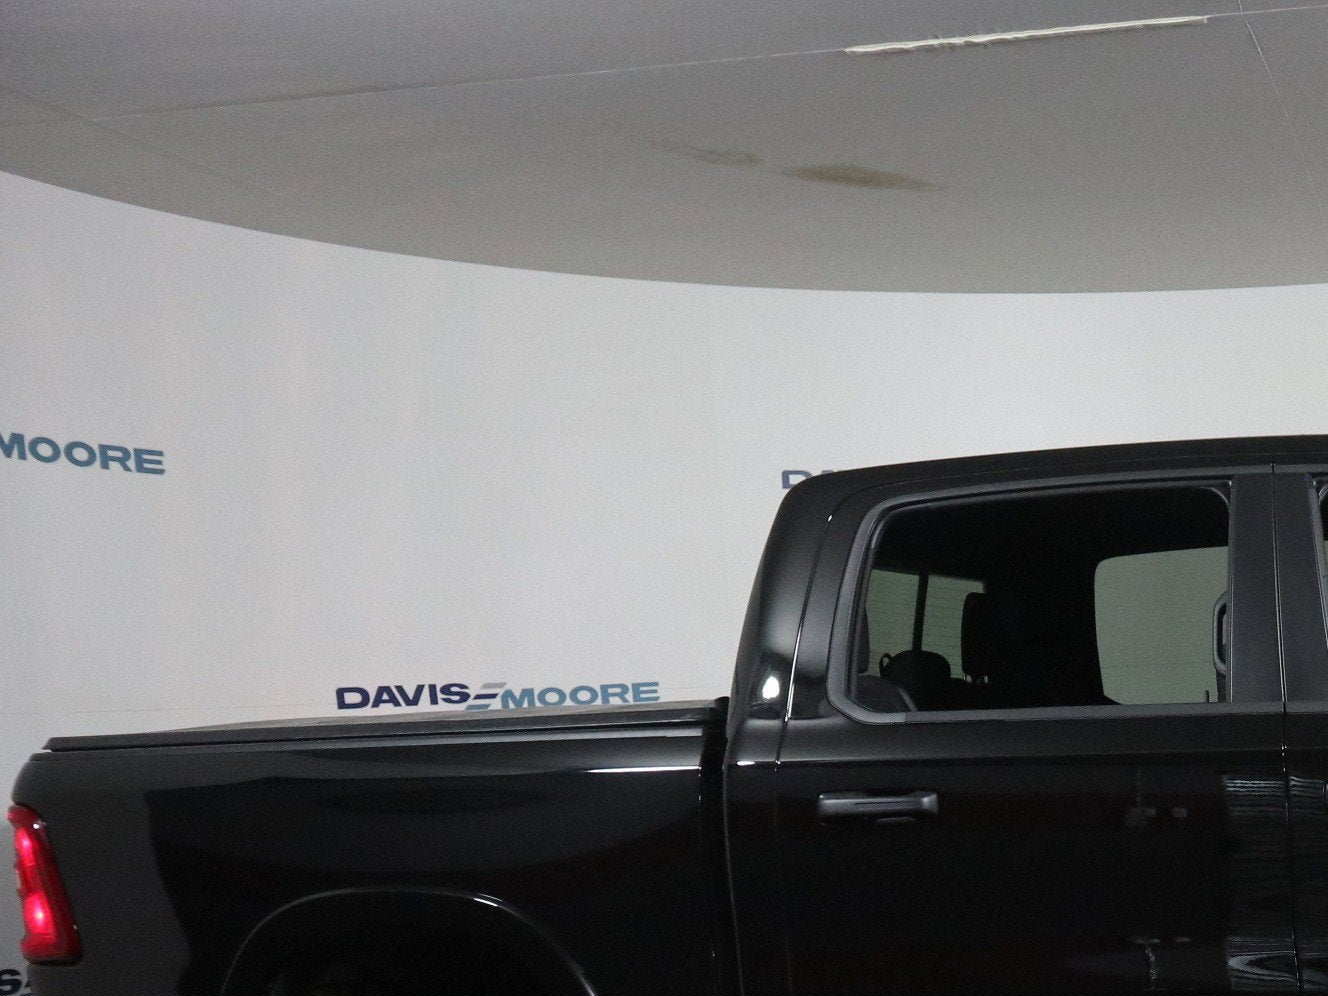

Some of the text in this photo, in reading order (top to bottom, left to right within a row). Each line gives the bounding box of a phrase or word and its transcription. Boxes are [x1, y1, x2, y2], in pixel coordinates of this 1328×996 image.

[0, 432, 166, 475] MOORE
[335, 682, 661, 709] DAVIS MOORE
